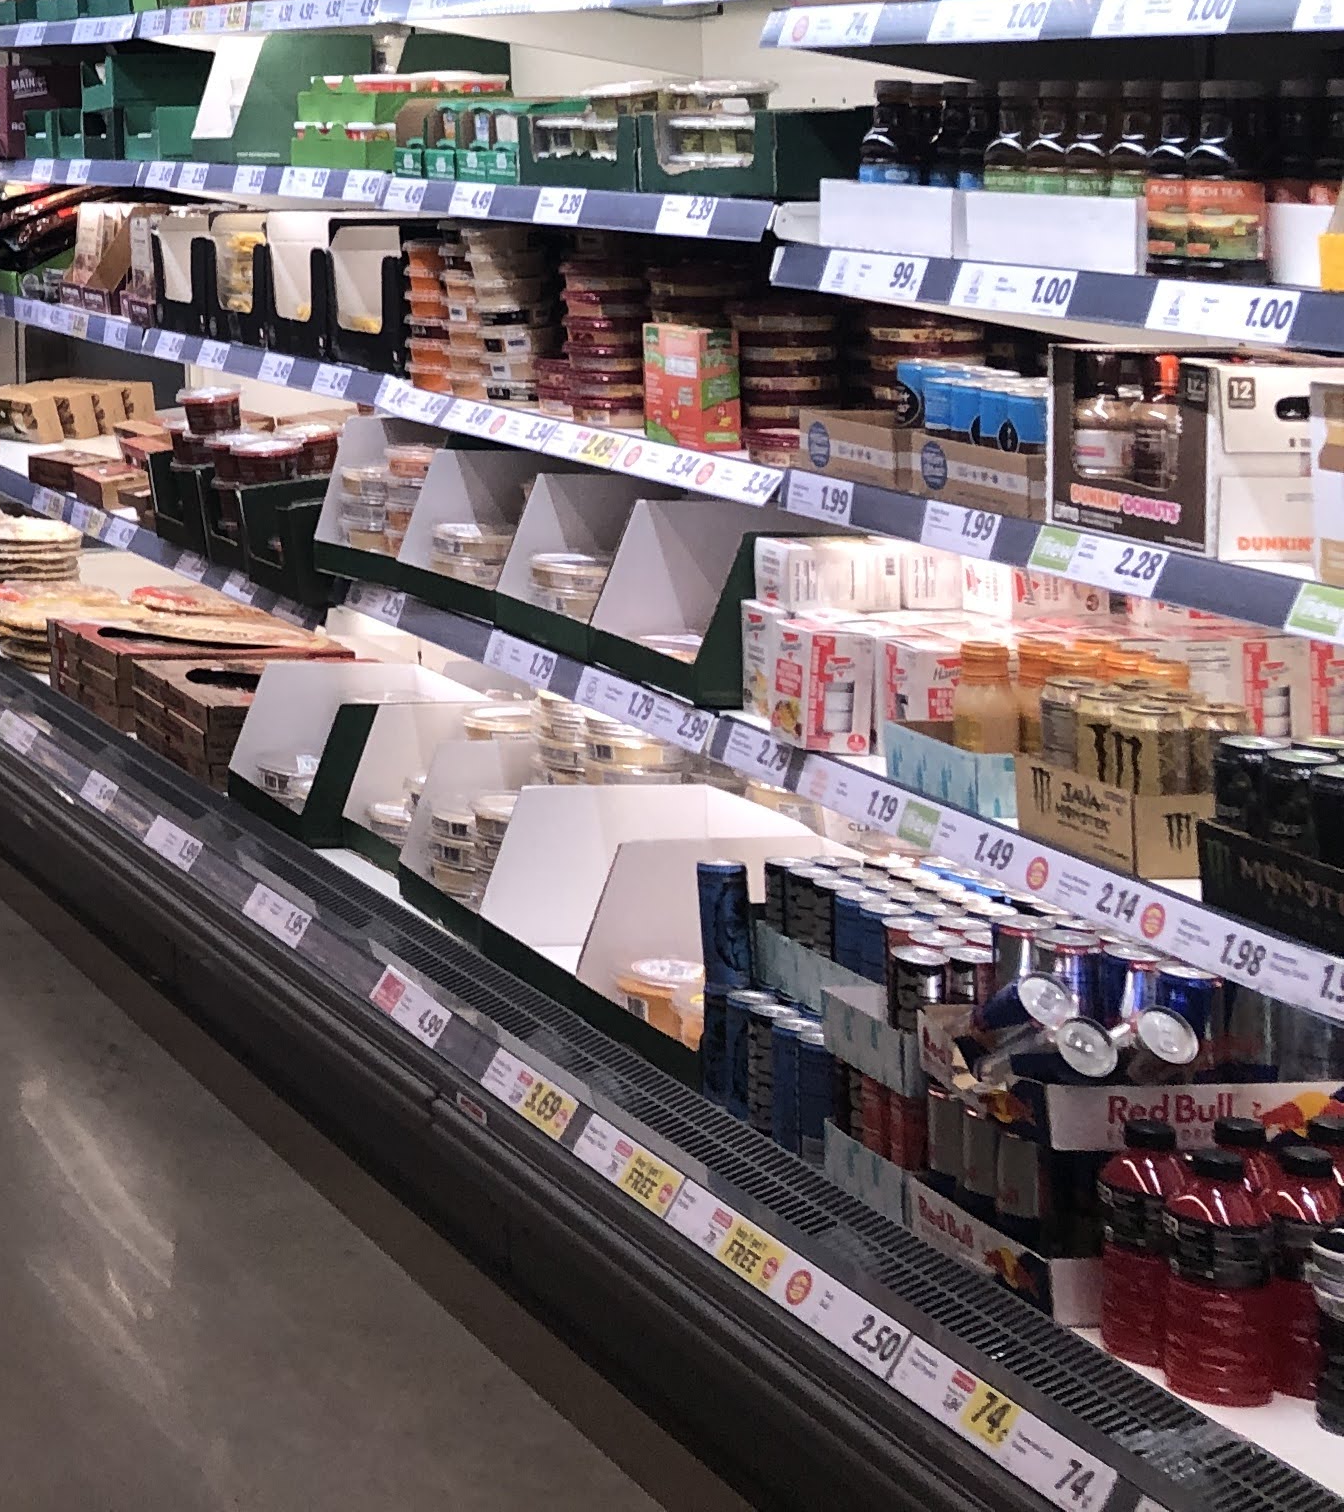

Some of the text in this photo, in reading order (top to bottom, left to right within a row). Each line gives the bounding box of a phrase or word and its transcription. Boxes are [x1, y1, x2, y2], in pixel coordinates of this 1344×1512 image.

[1007, 1, 1047, 29] 1.00
[470, 191, 491, 210] 4.49
[558, 194, 582, 215] 2.39
[686, 197, 713, 221] 2.39
[1031, 275, 1072, 306] 1.00
[1244, 297, 1294, 330] 1.00
[1230, 381, 1252, 399] 12
[581, 433, 611, 457] 2.49
[666, 453, 699, 477] 3.34
[742, 471, 779, 496] 3.34
[820, 485, 849, 516] 1.99
[960, 509, 997, 542] 1.99
[1113, 547, 1164, 581] 2.28
[529, 652, 556, 681] 1.79
[627, 691, 656, 721] 1.79
[677, 712, 709, 741] 2.99
[755, 739, 791, 773] 2.79
[865, 788, 899, 823] 1.19
[973, 832, 1014, 871] 1.49
[1095, 882, 1141, 923] 2.14
[1220, 932, 1267, 977] 1.98
[417, 1007, 445, 1038] 4.99
[524, 1081, 563, 1122] 3.69
[1107, 1092, 1233, 1124] Red Bull
[624, 1167, 659, 1201] FREE
[724, 1239, 762, 1275] FREE
[852, 1314, 901, 1364] 2.50
